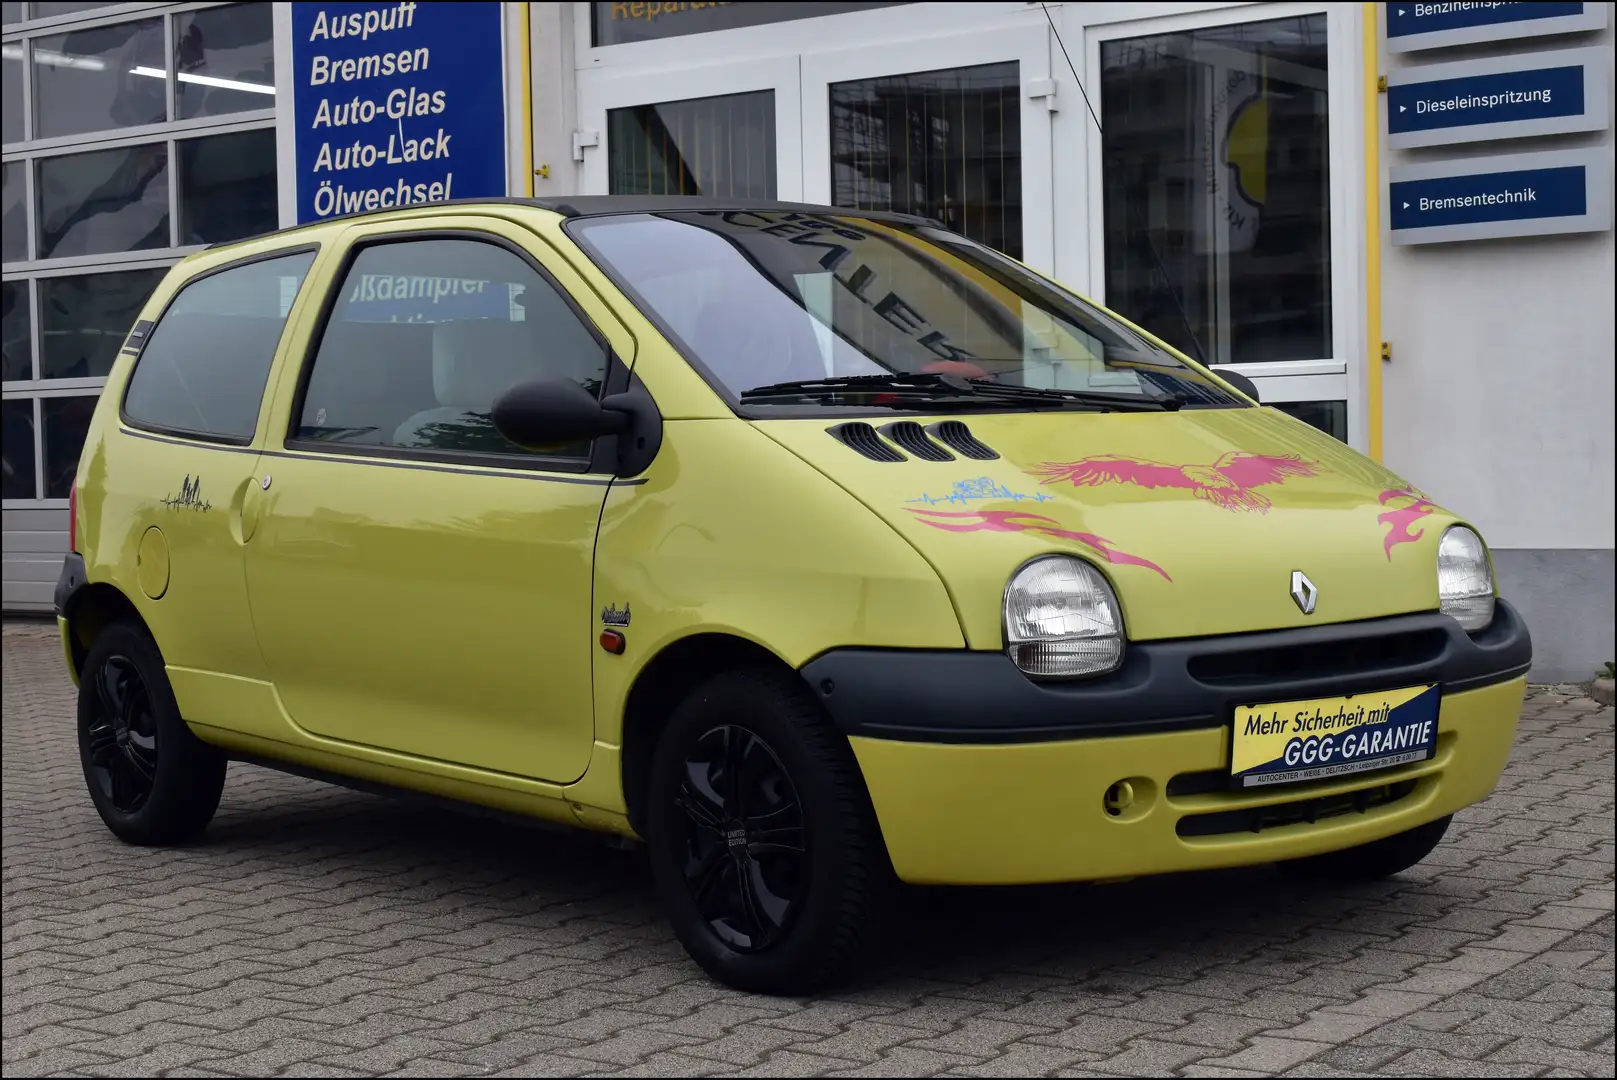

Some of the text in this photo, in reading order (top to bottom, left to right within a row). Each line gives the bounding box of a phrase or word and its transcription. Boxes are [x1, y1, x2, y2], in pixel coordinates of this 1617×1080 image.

[309, 2, 417, 41] Auspuff
[310, 47, 430, 86] Bremsen
[312, 87, 446, 129] Auto-Glas
[1416, 88, 1552, 114] Dieseleinspritzung
[313, 128, 452, 173] Auto-Lack
[314, 172, 453, 216] Ölwechsel
[1419, 187, 1537, 211] Bremsentechnik
[1243, 701, 1390, 736] Mehr Sicherheit mit
[1284, 720, 1432, 766] GGG-GARANTIE
[1257, 771, 1298, 783] AUTOCENTER
[1325, 763, 1355, 774] DELITZSCH
